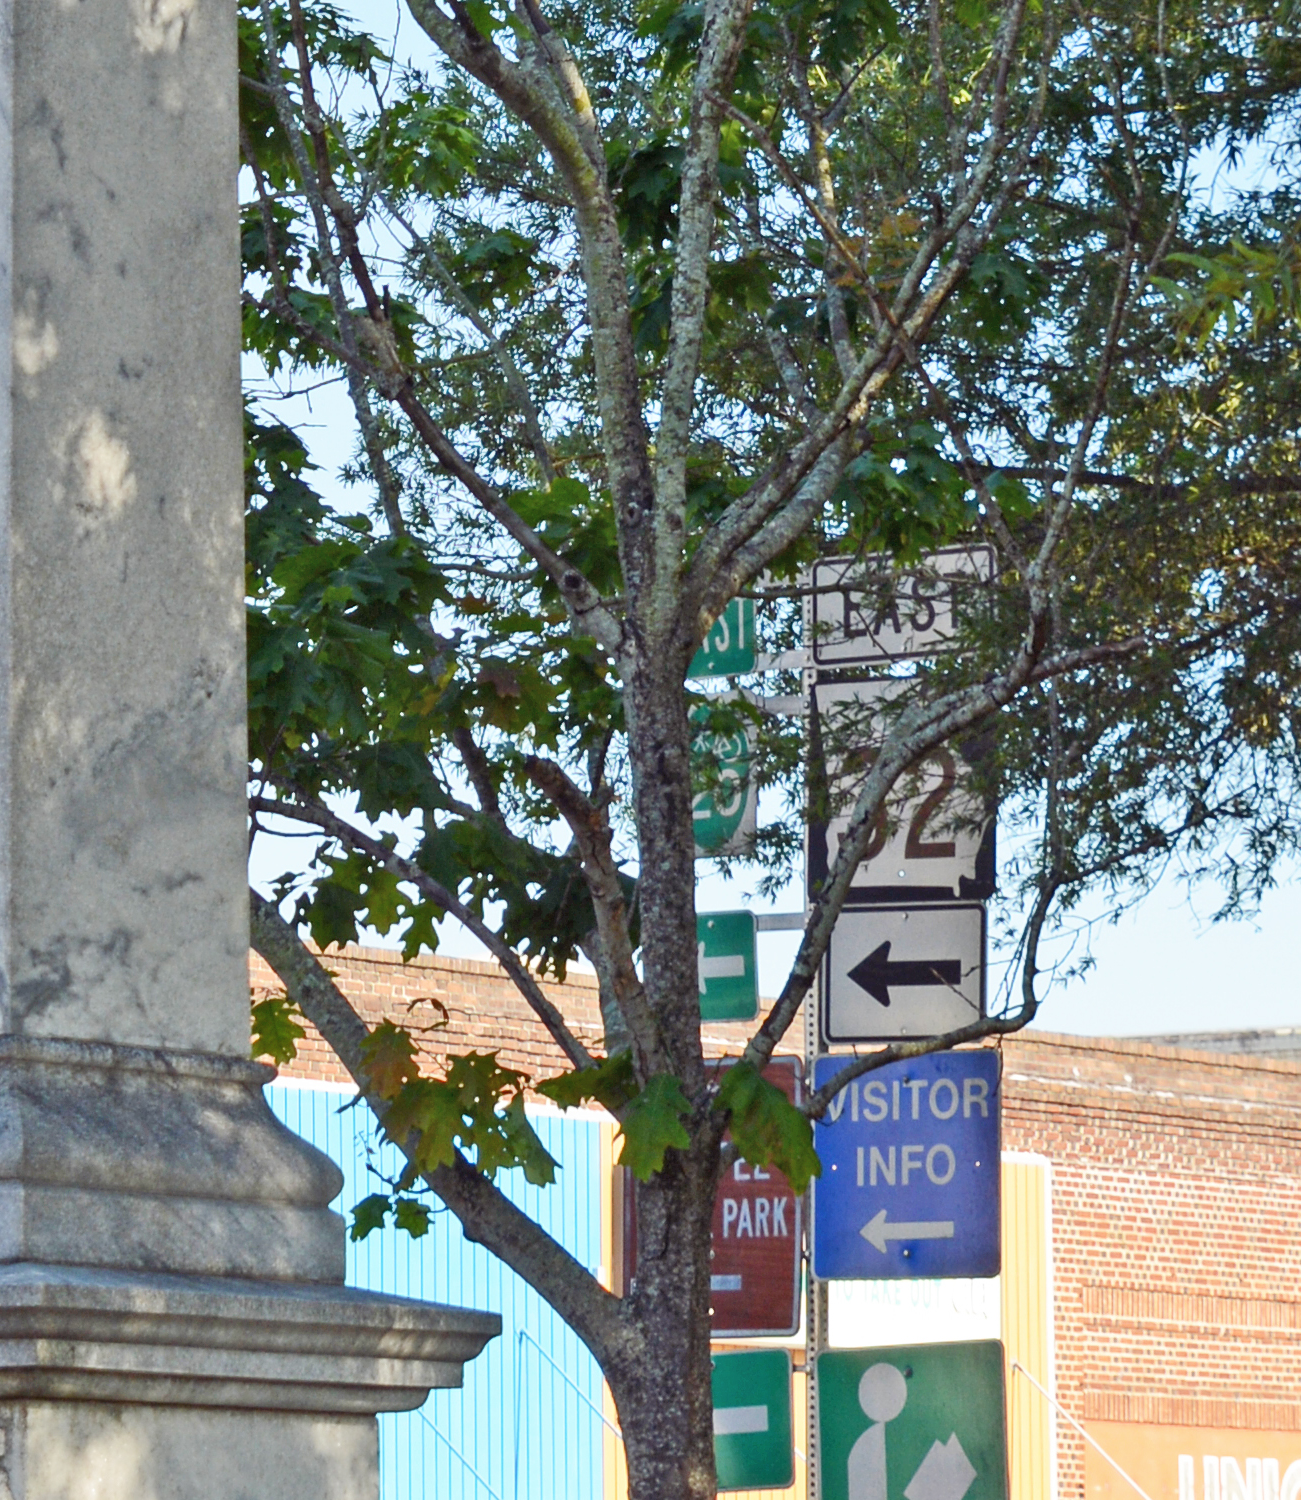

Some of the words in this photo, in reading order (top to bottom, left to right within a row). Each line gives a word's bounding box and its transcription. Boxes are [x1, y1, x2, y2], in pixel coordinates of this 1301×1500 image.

[843, 570, 969, 639] EAST
[828, 1077, 990, 1123] VISITOR
[856, 1143, 956, 1187] INFO
[722, 1196, 789, 1239] PARK
[911, 1280, 942, 1309] OUT
